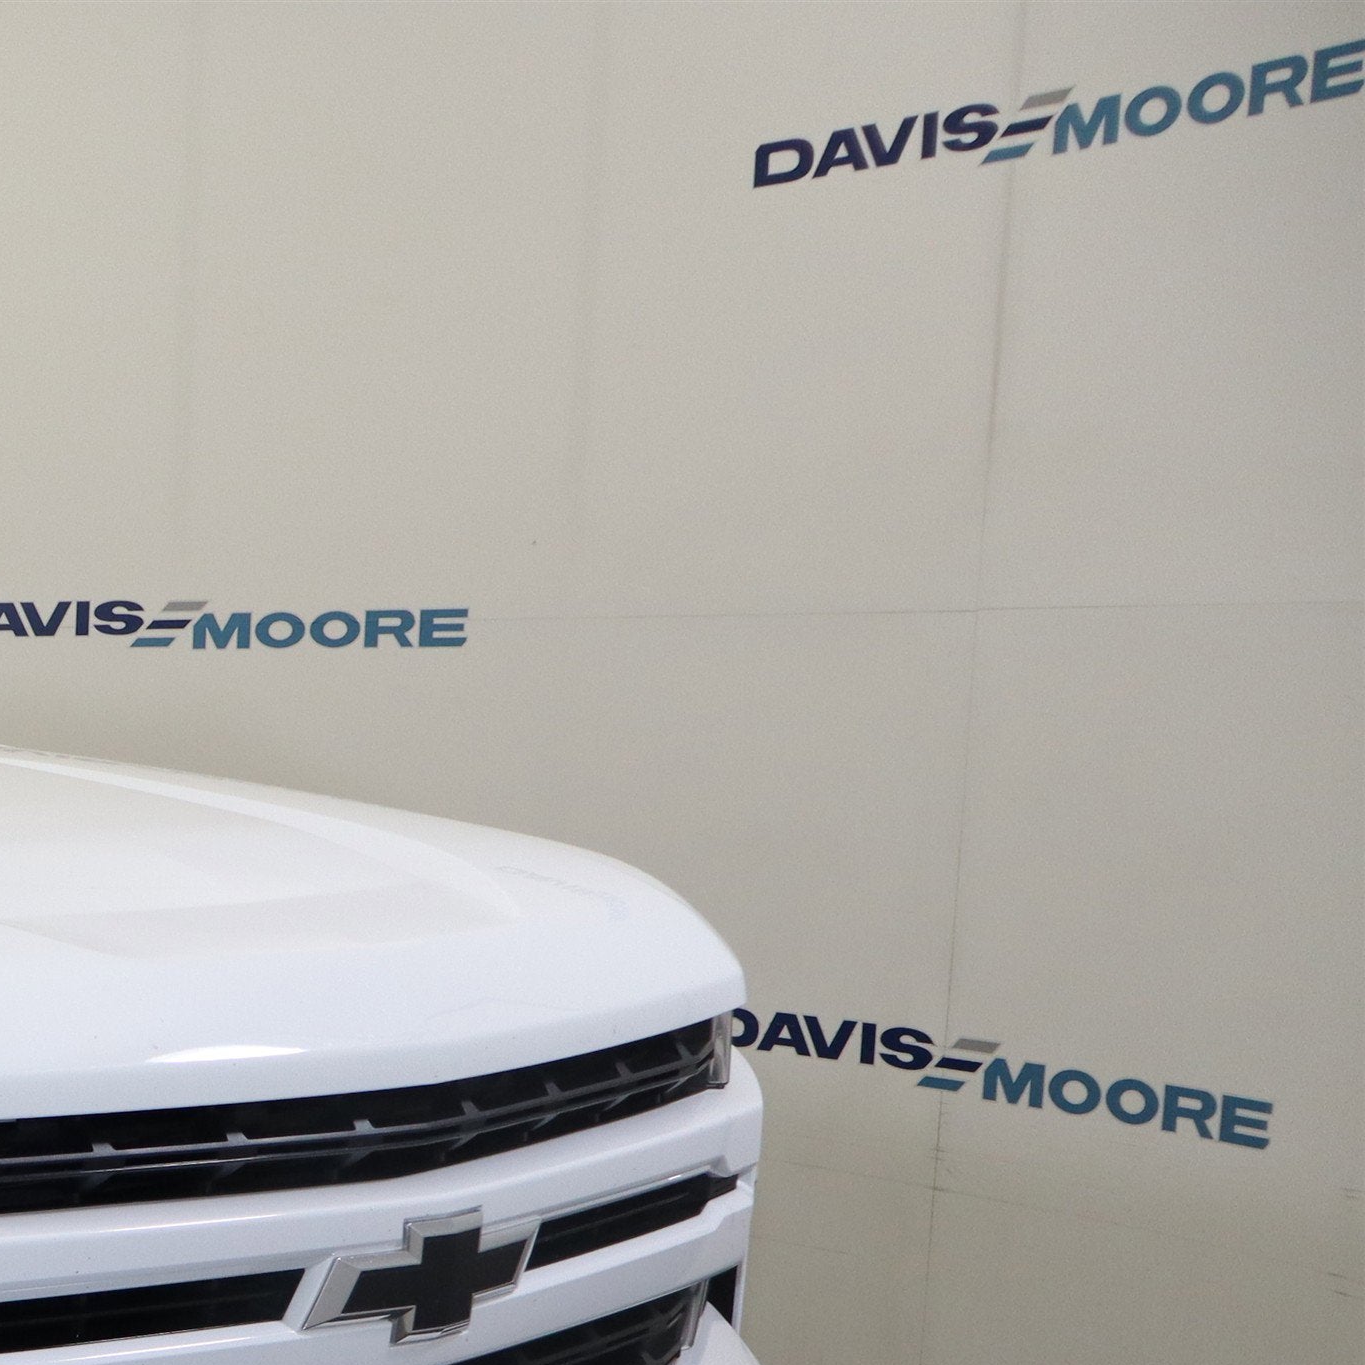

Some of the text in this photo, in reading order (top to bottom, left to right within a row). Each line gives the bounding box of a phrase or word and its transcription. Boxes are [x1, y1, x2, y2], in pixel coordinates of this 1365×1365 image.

[753, 39, 1365, 189] DAVIS MOORE
[192, 608, 469, 649] MOORE
[982, 1057, 1273, 1150] MOORE
